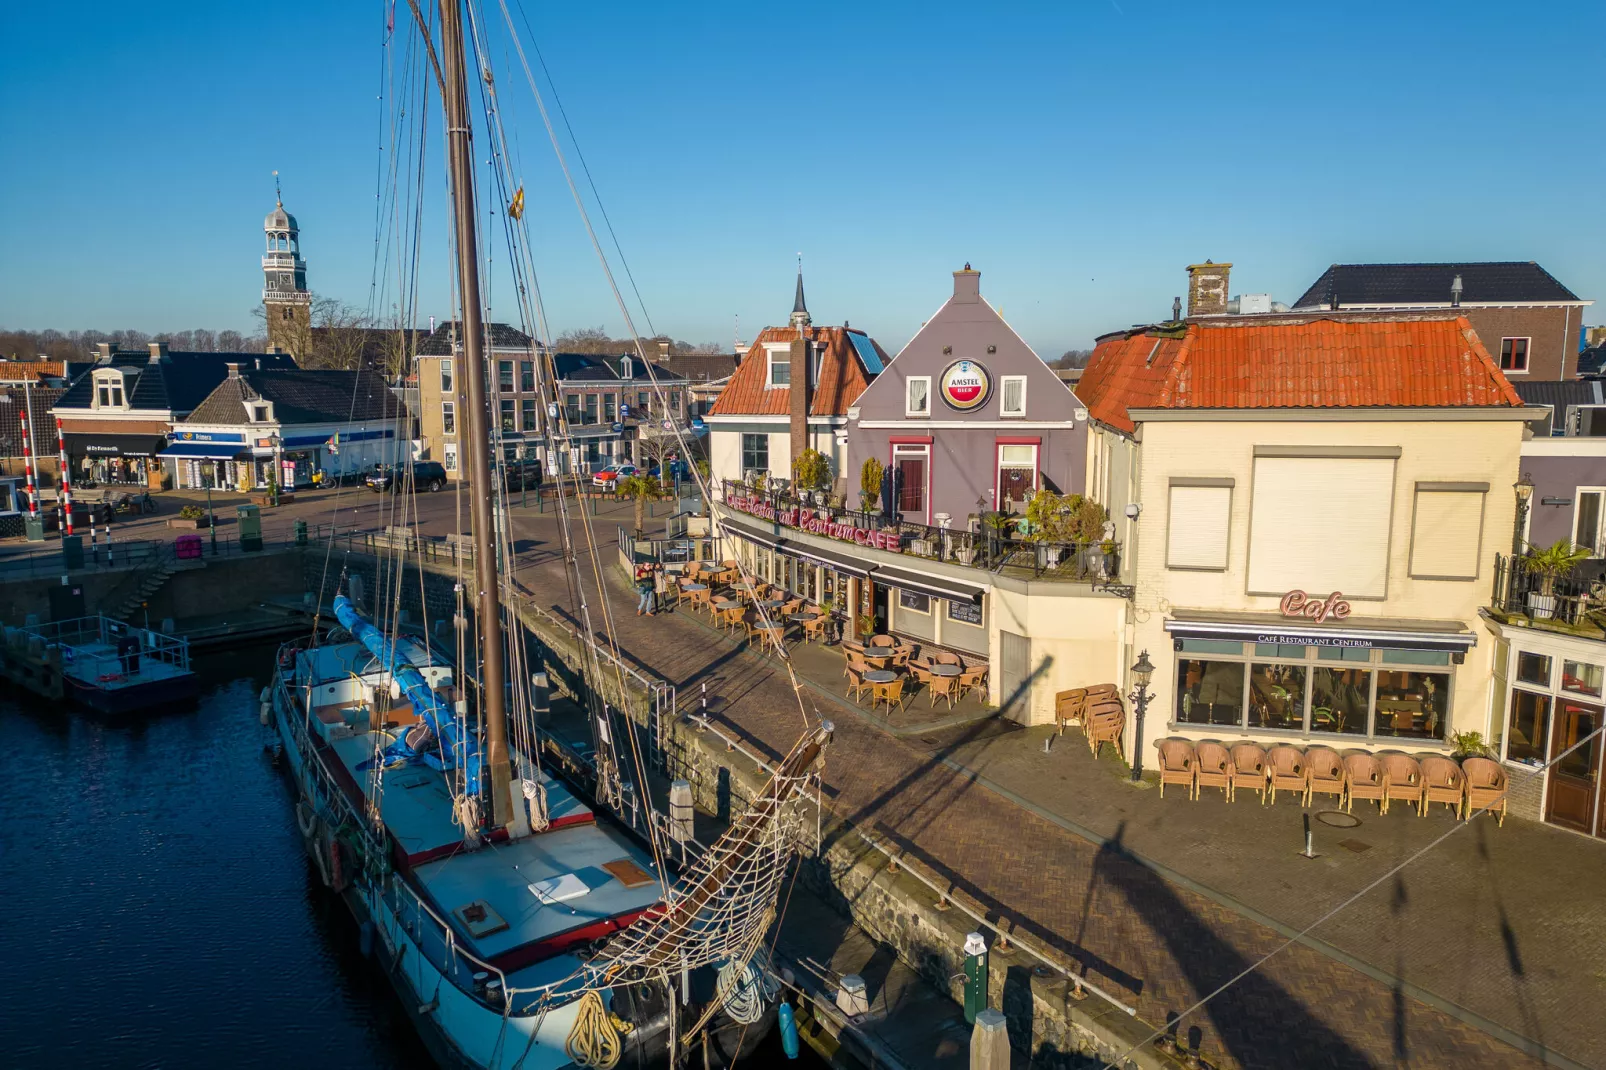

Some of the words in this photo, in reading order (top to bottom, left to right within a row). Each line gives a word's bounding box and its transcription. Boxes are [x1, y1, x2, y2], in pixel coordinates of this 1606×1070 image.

[800, 508, 858, 541] Centrum
[854, 528, 901, 552] CAFE
[1279, 589, 1352, 624] Cafe
[1280, 636, 1329, 645] RESTAURANT
[1333, 638, 1373, 647] CENTRUM
